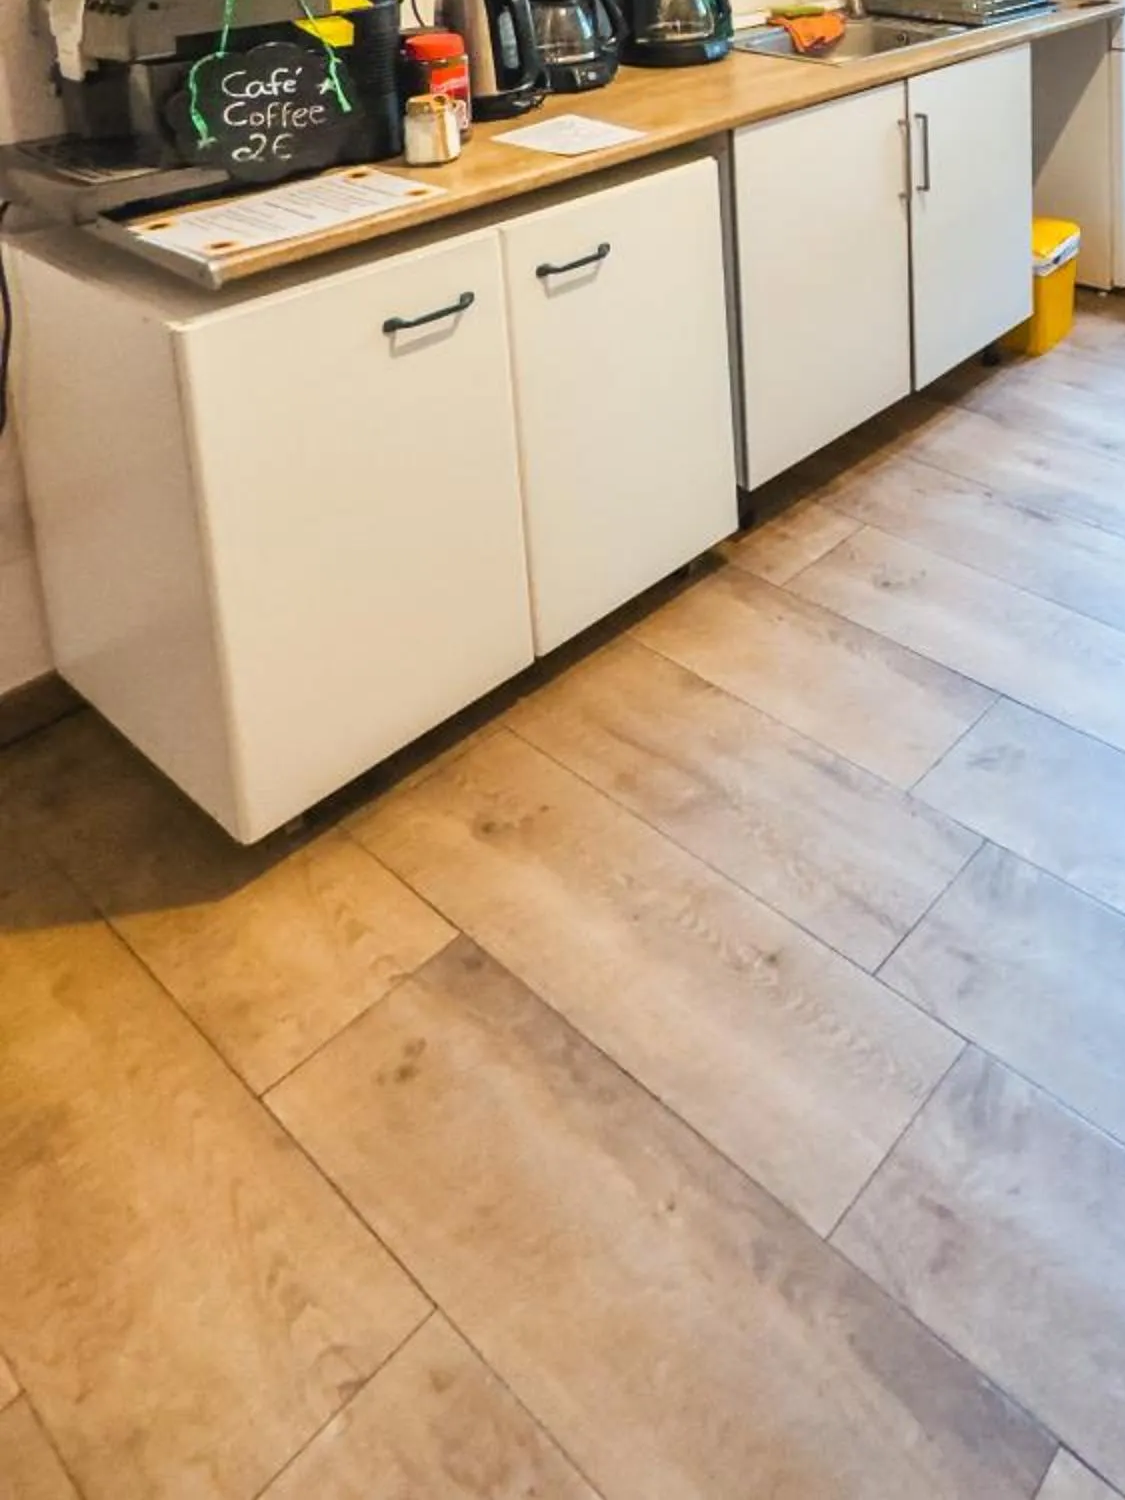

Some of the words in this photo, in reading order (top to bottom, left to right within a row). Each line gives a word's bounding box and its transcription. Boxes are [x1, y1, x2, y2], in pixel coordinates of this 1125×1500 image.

[221, 67, 303, 98] Café
[223, 101, 327, 128] Coffee
[231, 132, 294, 162] 2€
